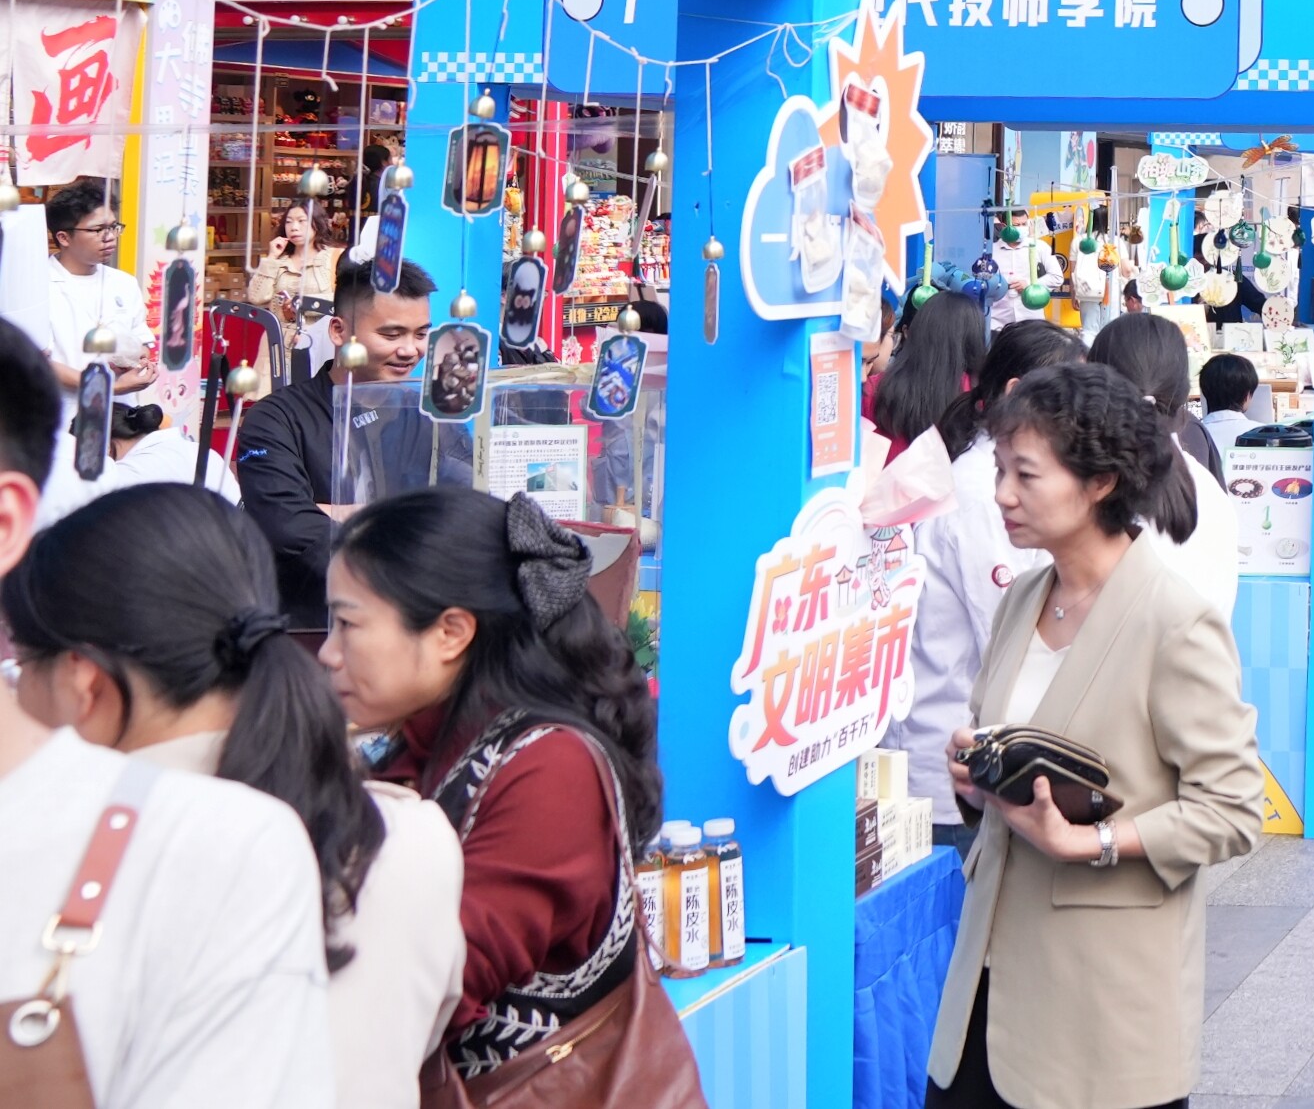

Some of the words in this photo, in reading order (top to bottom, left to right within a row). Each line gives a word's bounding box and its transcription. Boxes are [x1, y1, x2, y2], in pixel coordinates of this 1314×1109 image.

[25, 15, 119, 162] 画
[741, 543, 838, 679] 广东
[751, 603, 915, 753] 文明集市
[685, 894, 700, 943] 陈皮水
[725, 882, 739, 932] 陈皮水
